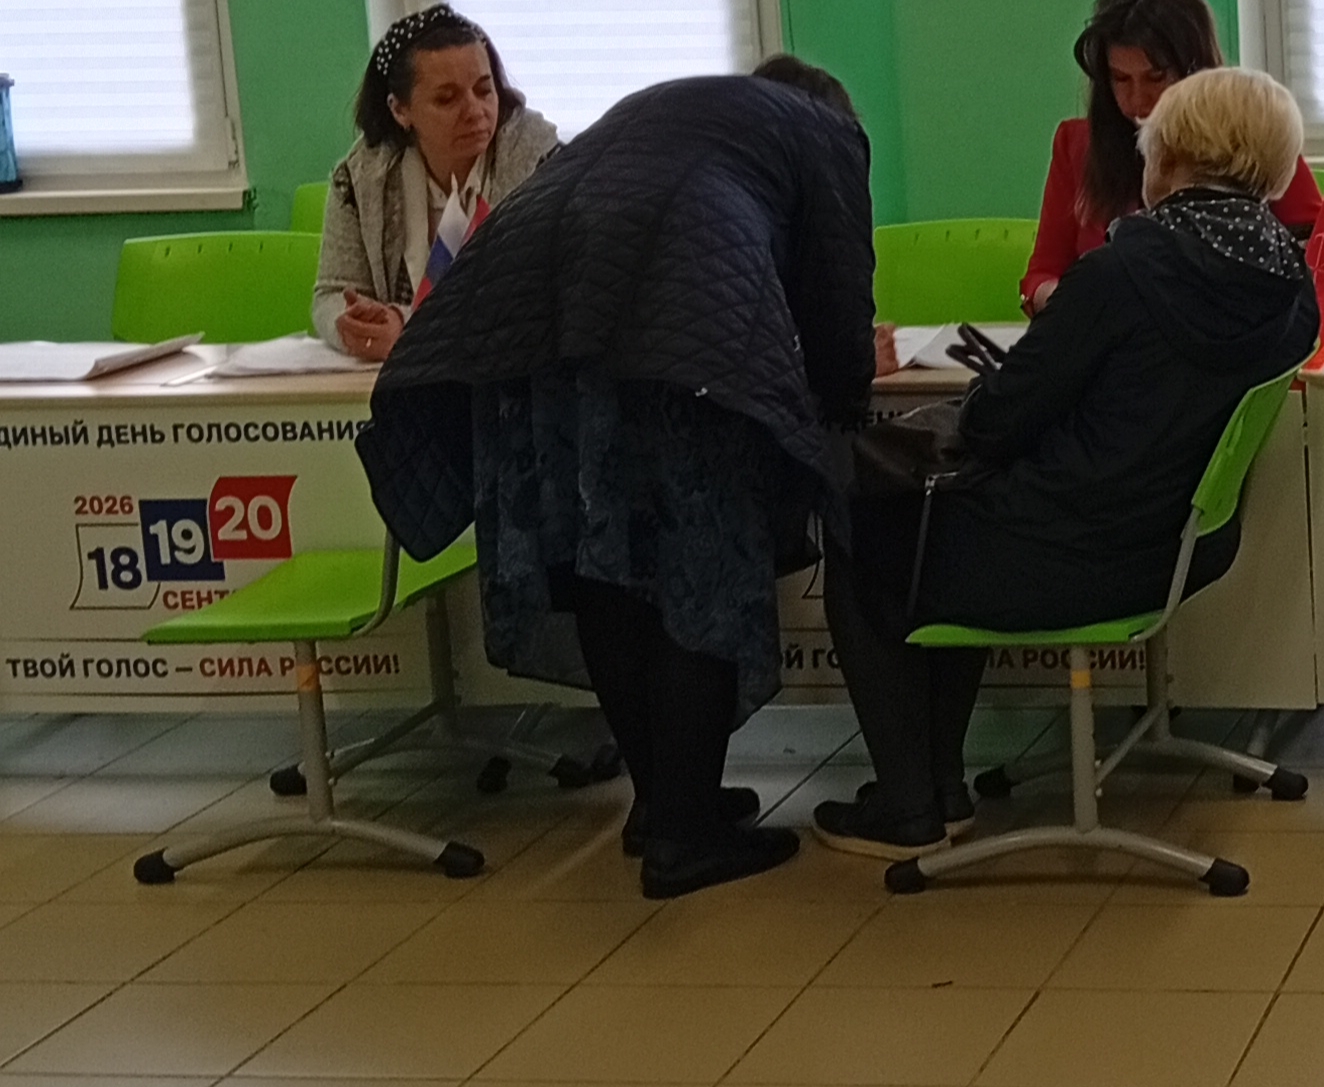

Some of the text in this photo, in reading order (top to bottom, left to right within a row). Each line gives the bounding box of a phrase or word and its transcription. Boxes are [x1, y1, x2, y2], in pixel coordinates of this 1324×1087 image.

[0, 420, 90, 450] ДИНЫЙ
[96, 423, 166, 449] ДЕНЬ
[73, 494, 134, 516] 2026
[87, 495, 283, 591] 18 19 20
[5, 653, 76, 678] ТВОЙ
[82, 656, 169, 679] ГОЛОС
[199, 655, 273, 678] СИЛА
[279, 653, 401, 678] РССИИ!
